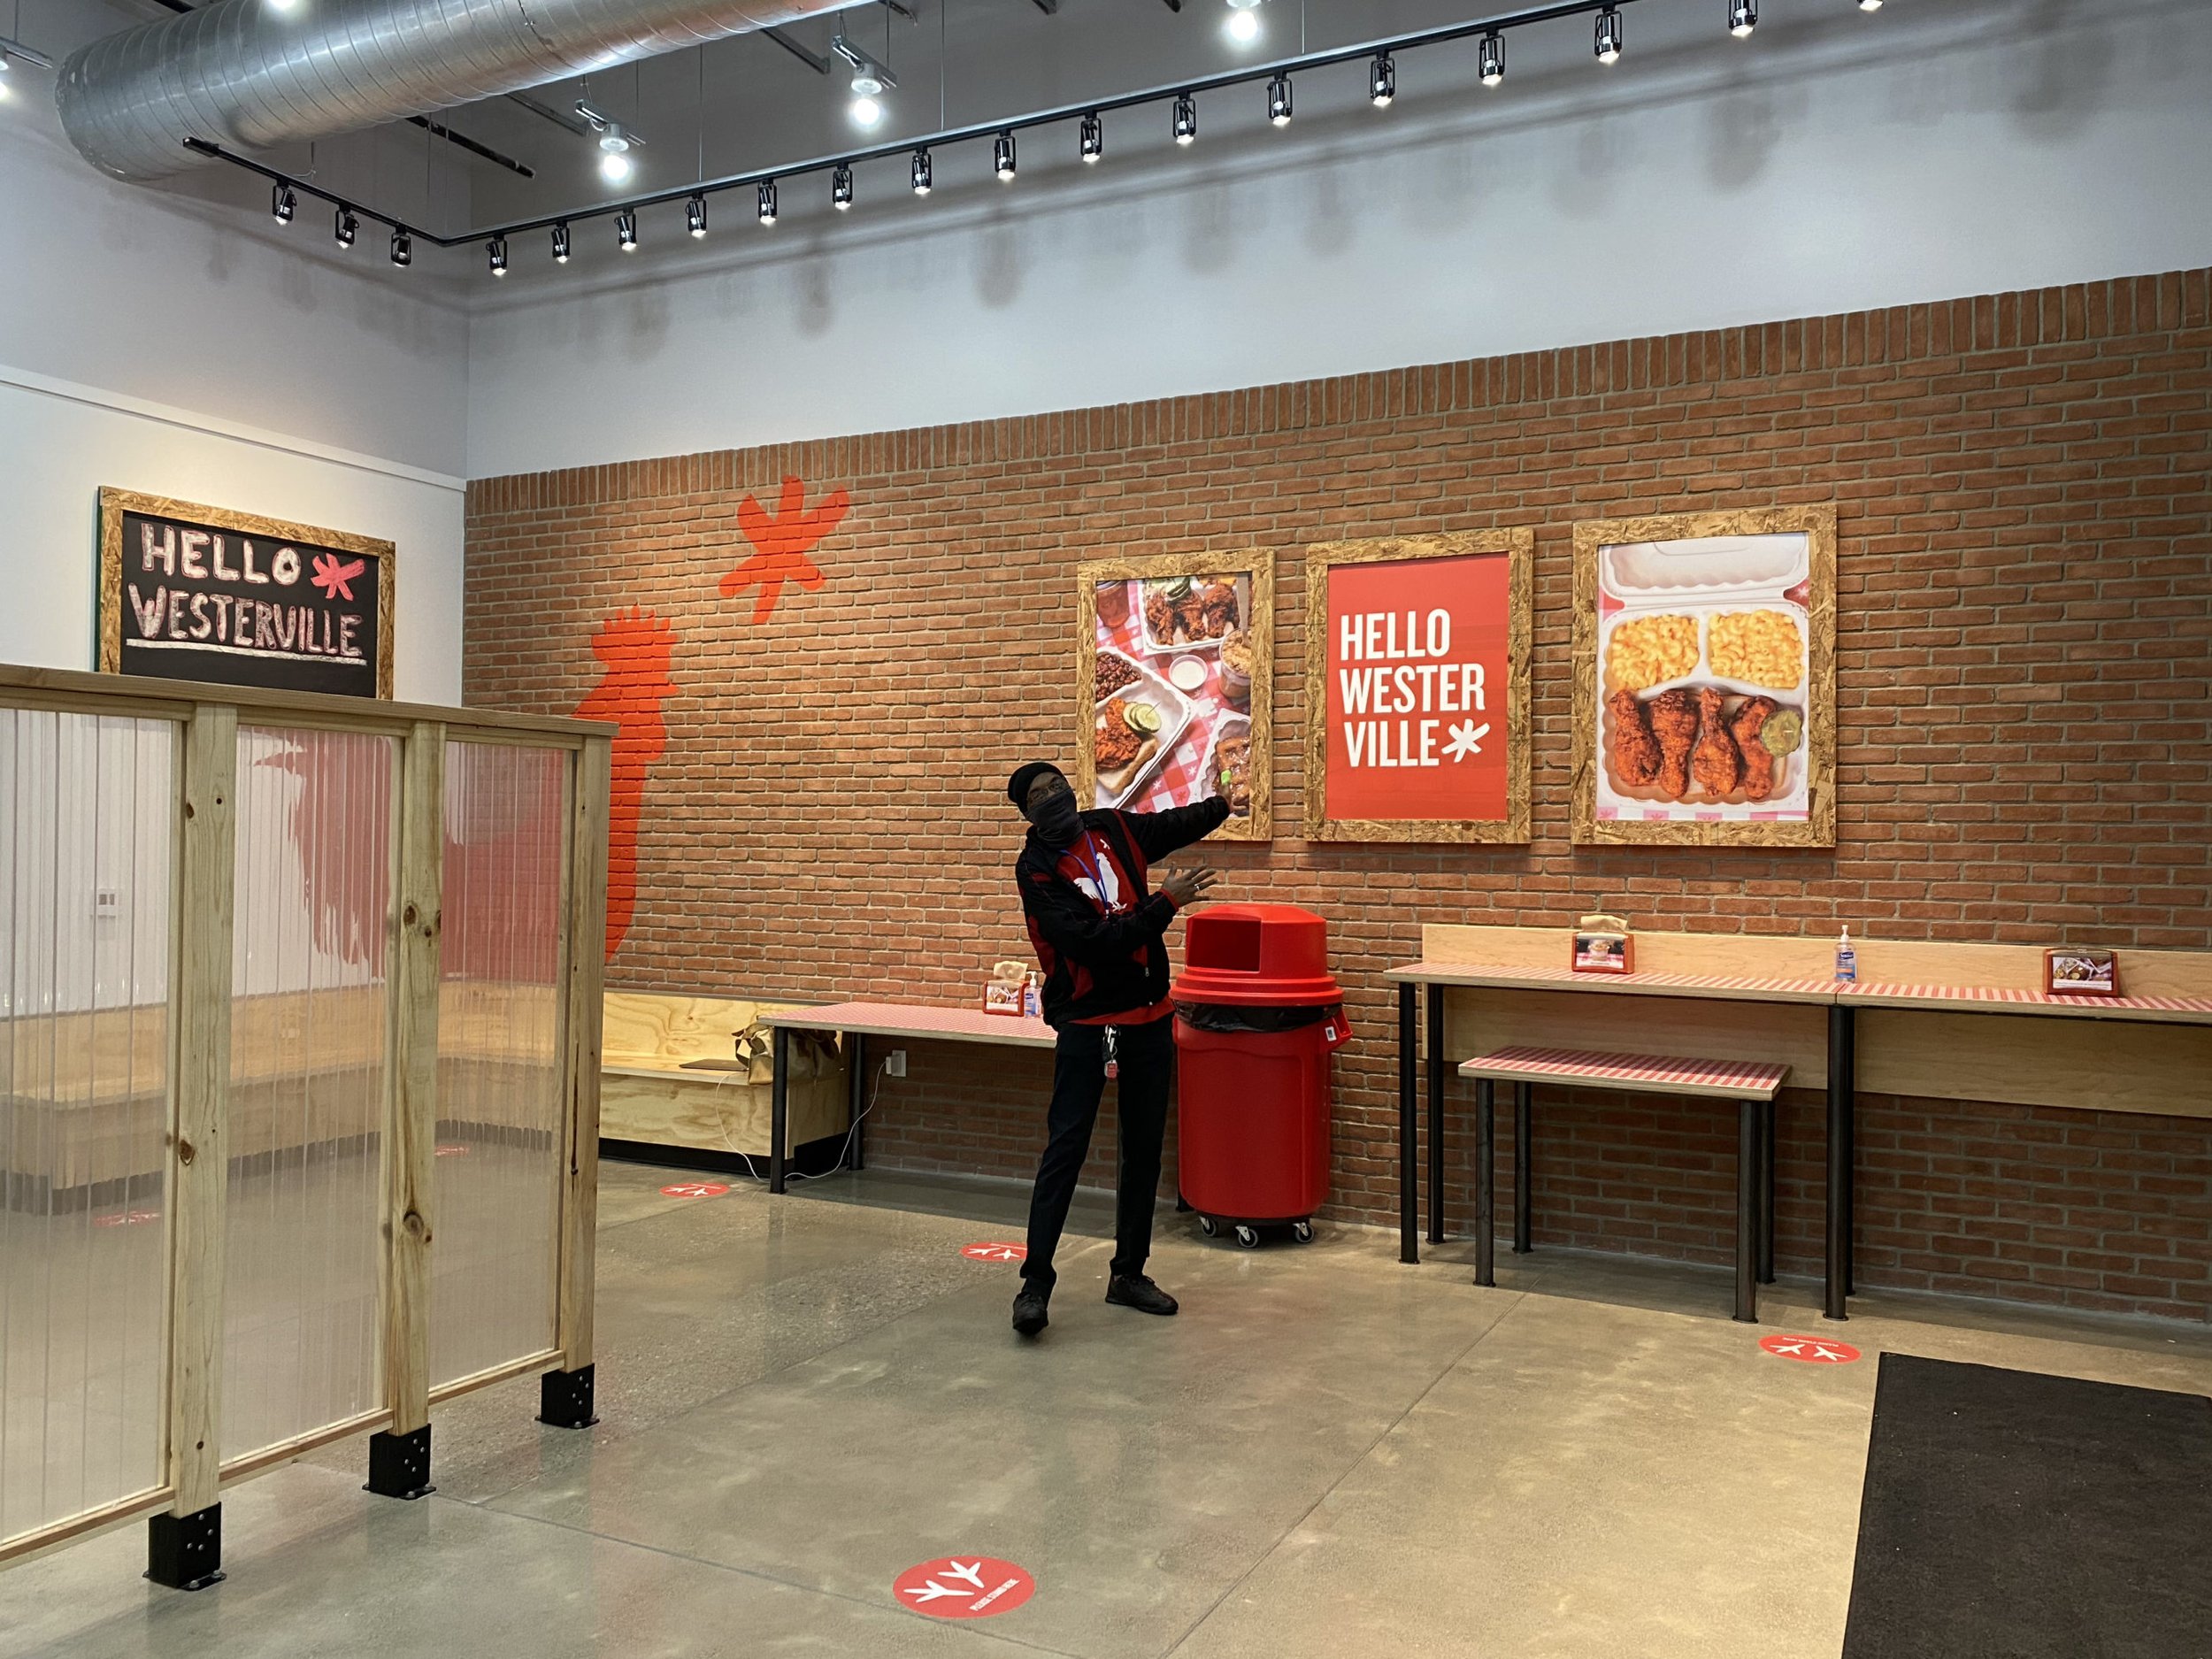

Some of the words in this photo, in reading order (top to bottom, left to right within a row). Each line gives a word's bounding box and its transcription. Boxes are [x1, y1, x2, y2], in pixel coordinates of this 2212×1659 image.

[140, 522, 302, 586] HELLO
[127, 582, 364, 657] WESTERVILLE
[1340, 608, 1451, 661] HELLO
[1339, 663, 1486, 715] WESTER
[1343, 718, 1440, 768] VILLE
